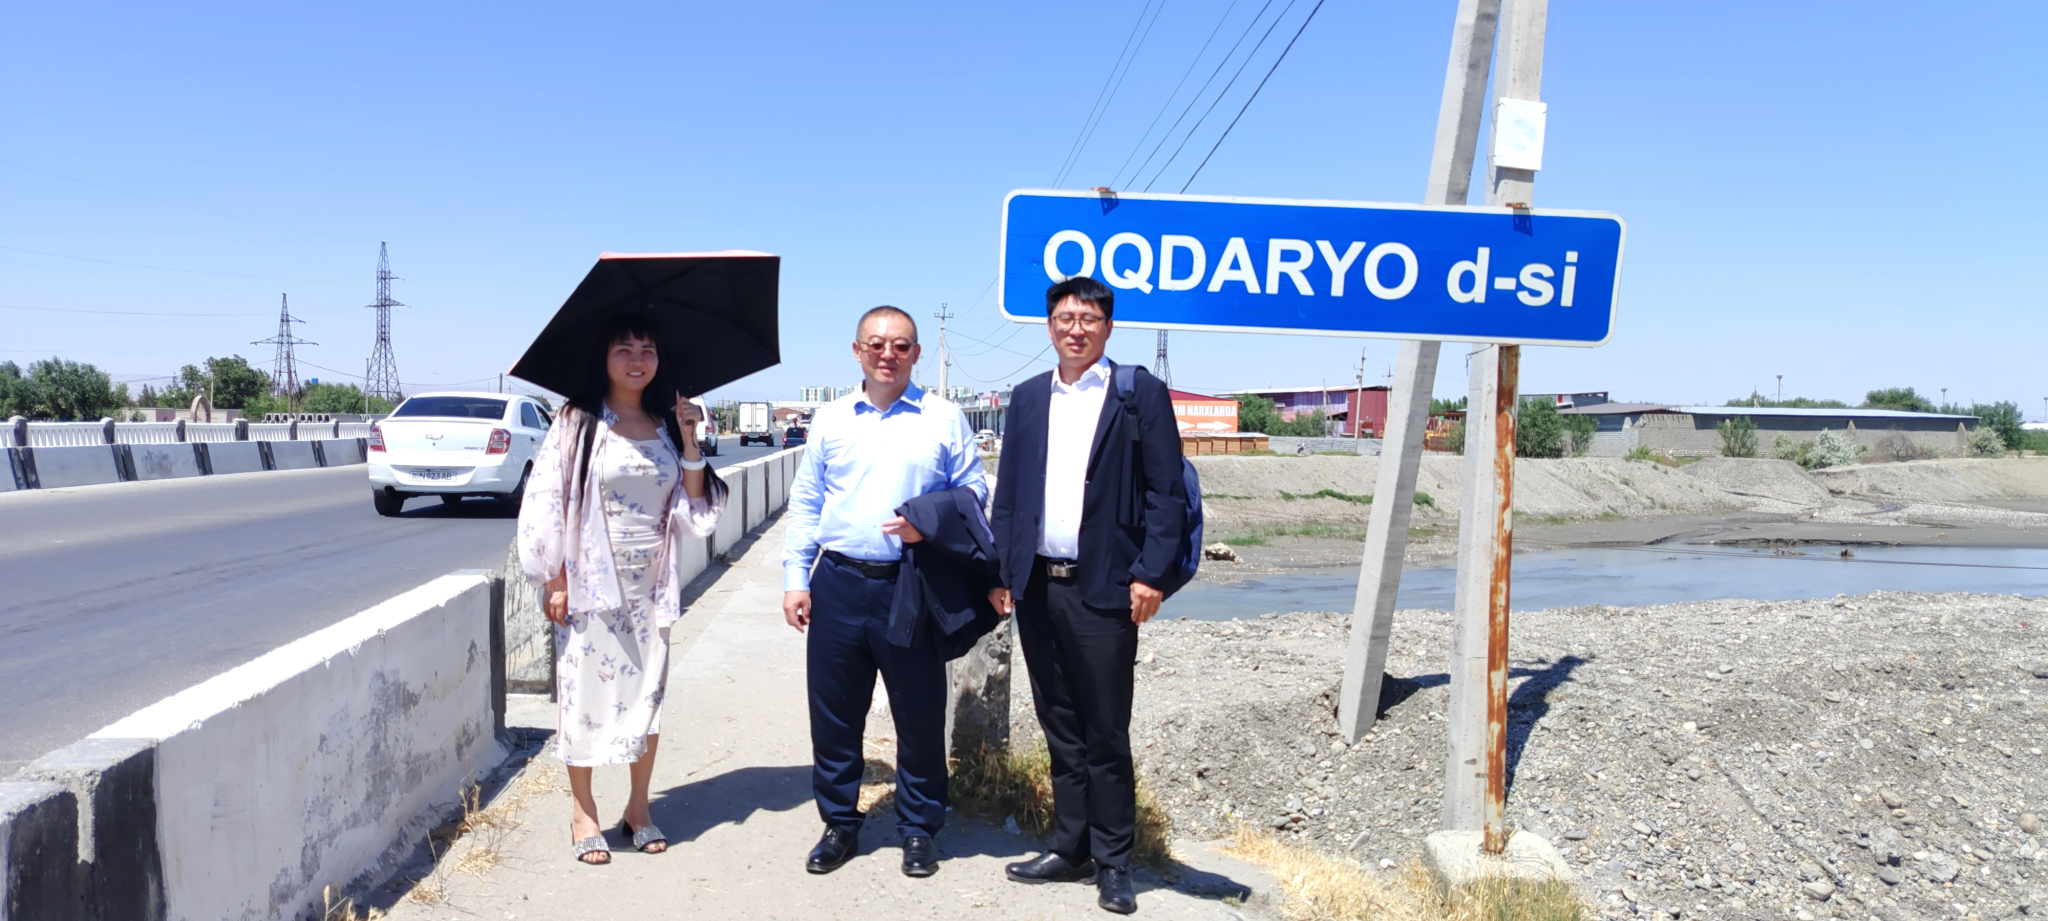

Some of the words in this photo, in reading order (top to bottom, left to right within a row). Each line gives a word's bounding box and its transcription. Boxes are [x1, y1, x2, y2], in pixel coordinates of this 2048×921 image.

[1043, 229, 1419, 300] OQDARYO
[1447, 247, 1579, 307] d-si
[1187, 405, 1238, 417] NARXLARDA
